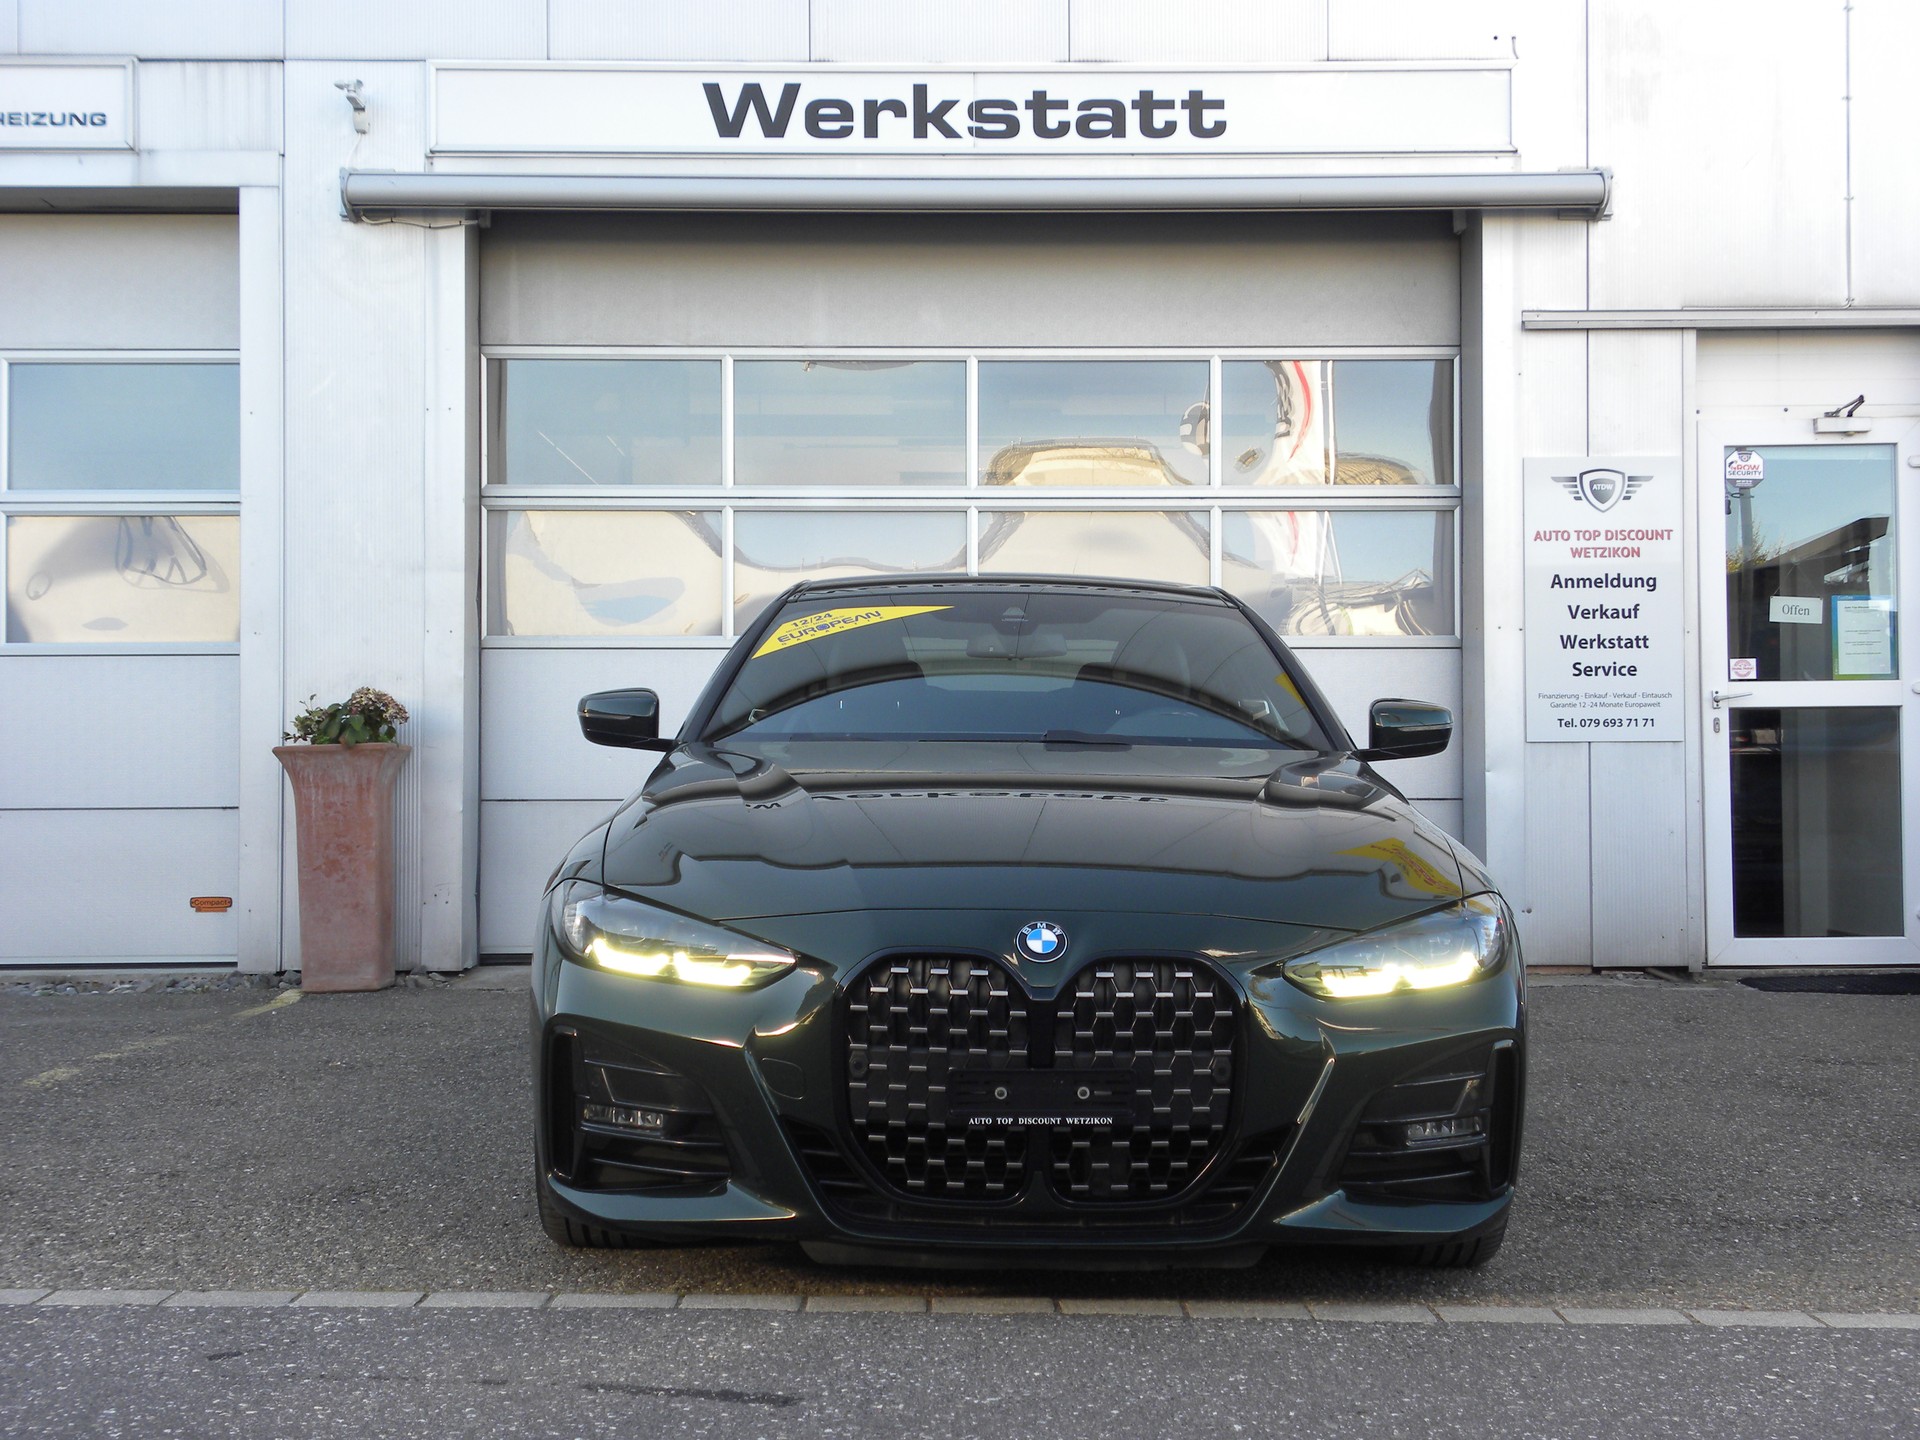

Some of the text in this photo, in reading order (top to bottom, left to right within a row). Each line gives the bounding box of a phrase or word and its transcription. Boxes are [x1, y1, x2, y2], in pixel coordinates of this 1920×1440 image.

[702, 82, 1228, 140] Werkstatt
[0, 112, 107, 127] EIZUNG
[1533, 529, 1674, 542] AUTO TOP DISCOUNT
[1570, 546, 1641, 559] WETZIKON
[1550, 573, 1657, 592] Anmeldung
[1567, 603, 1641, 620] Verkauf
[1781, 604, 1811, 616] Offen
[777, 610, 882, 643] EUROPEAN
[791, 612, 833, 627] 12/24
[1559, 633, 1650, 650] Werkstatt
[1572, 661, 1638, 677] Service
[1538, 692, 1580, 700] Finanzierung
[1612, 691, 1638, 699] Verkauf
[1641, 691, 1673, 699] Eintausch
[1624, 701, 1662, 709] Europaweit
[1557, 718, 1655, 728] Tel. 079 693 71 71
[968, 1117, 1113, 1125] AUTO TOP DISCOUNT WETZIKON
